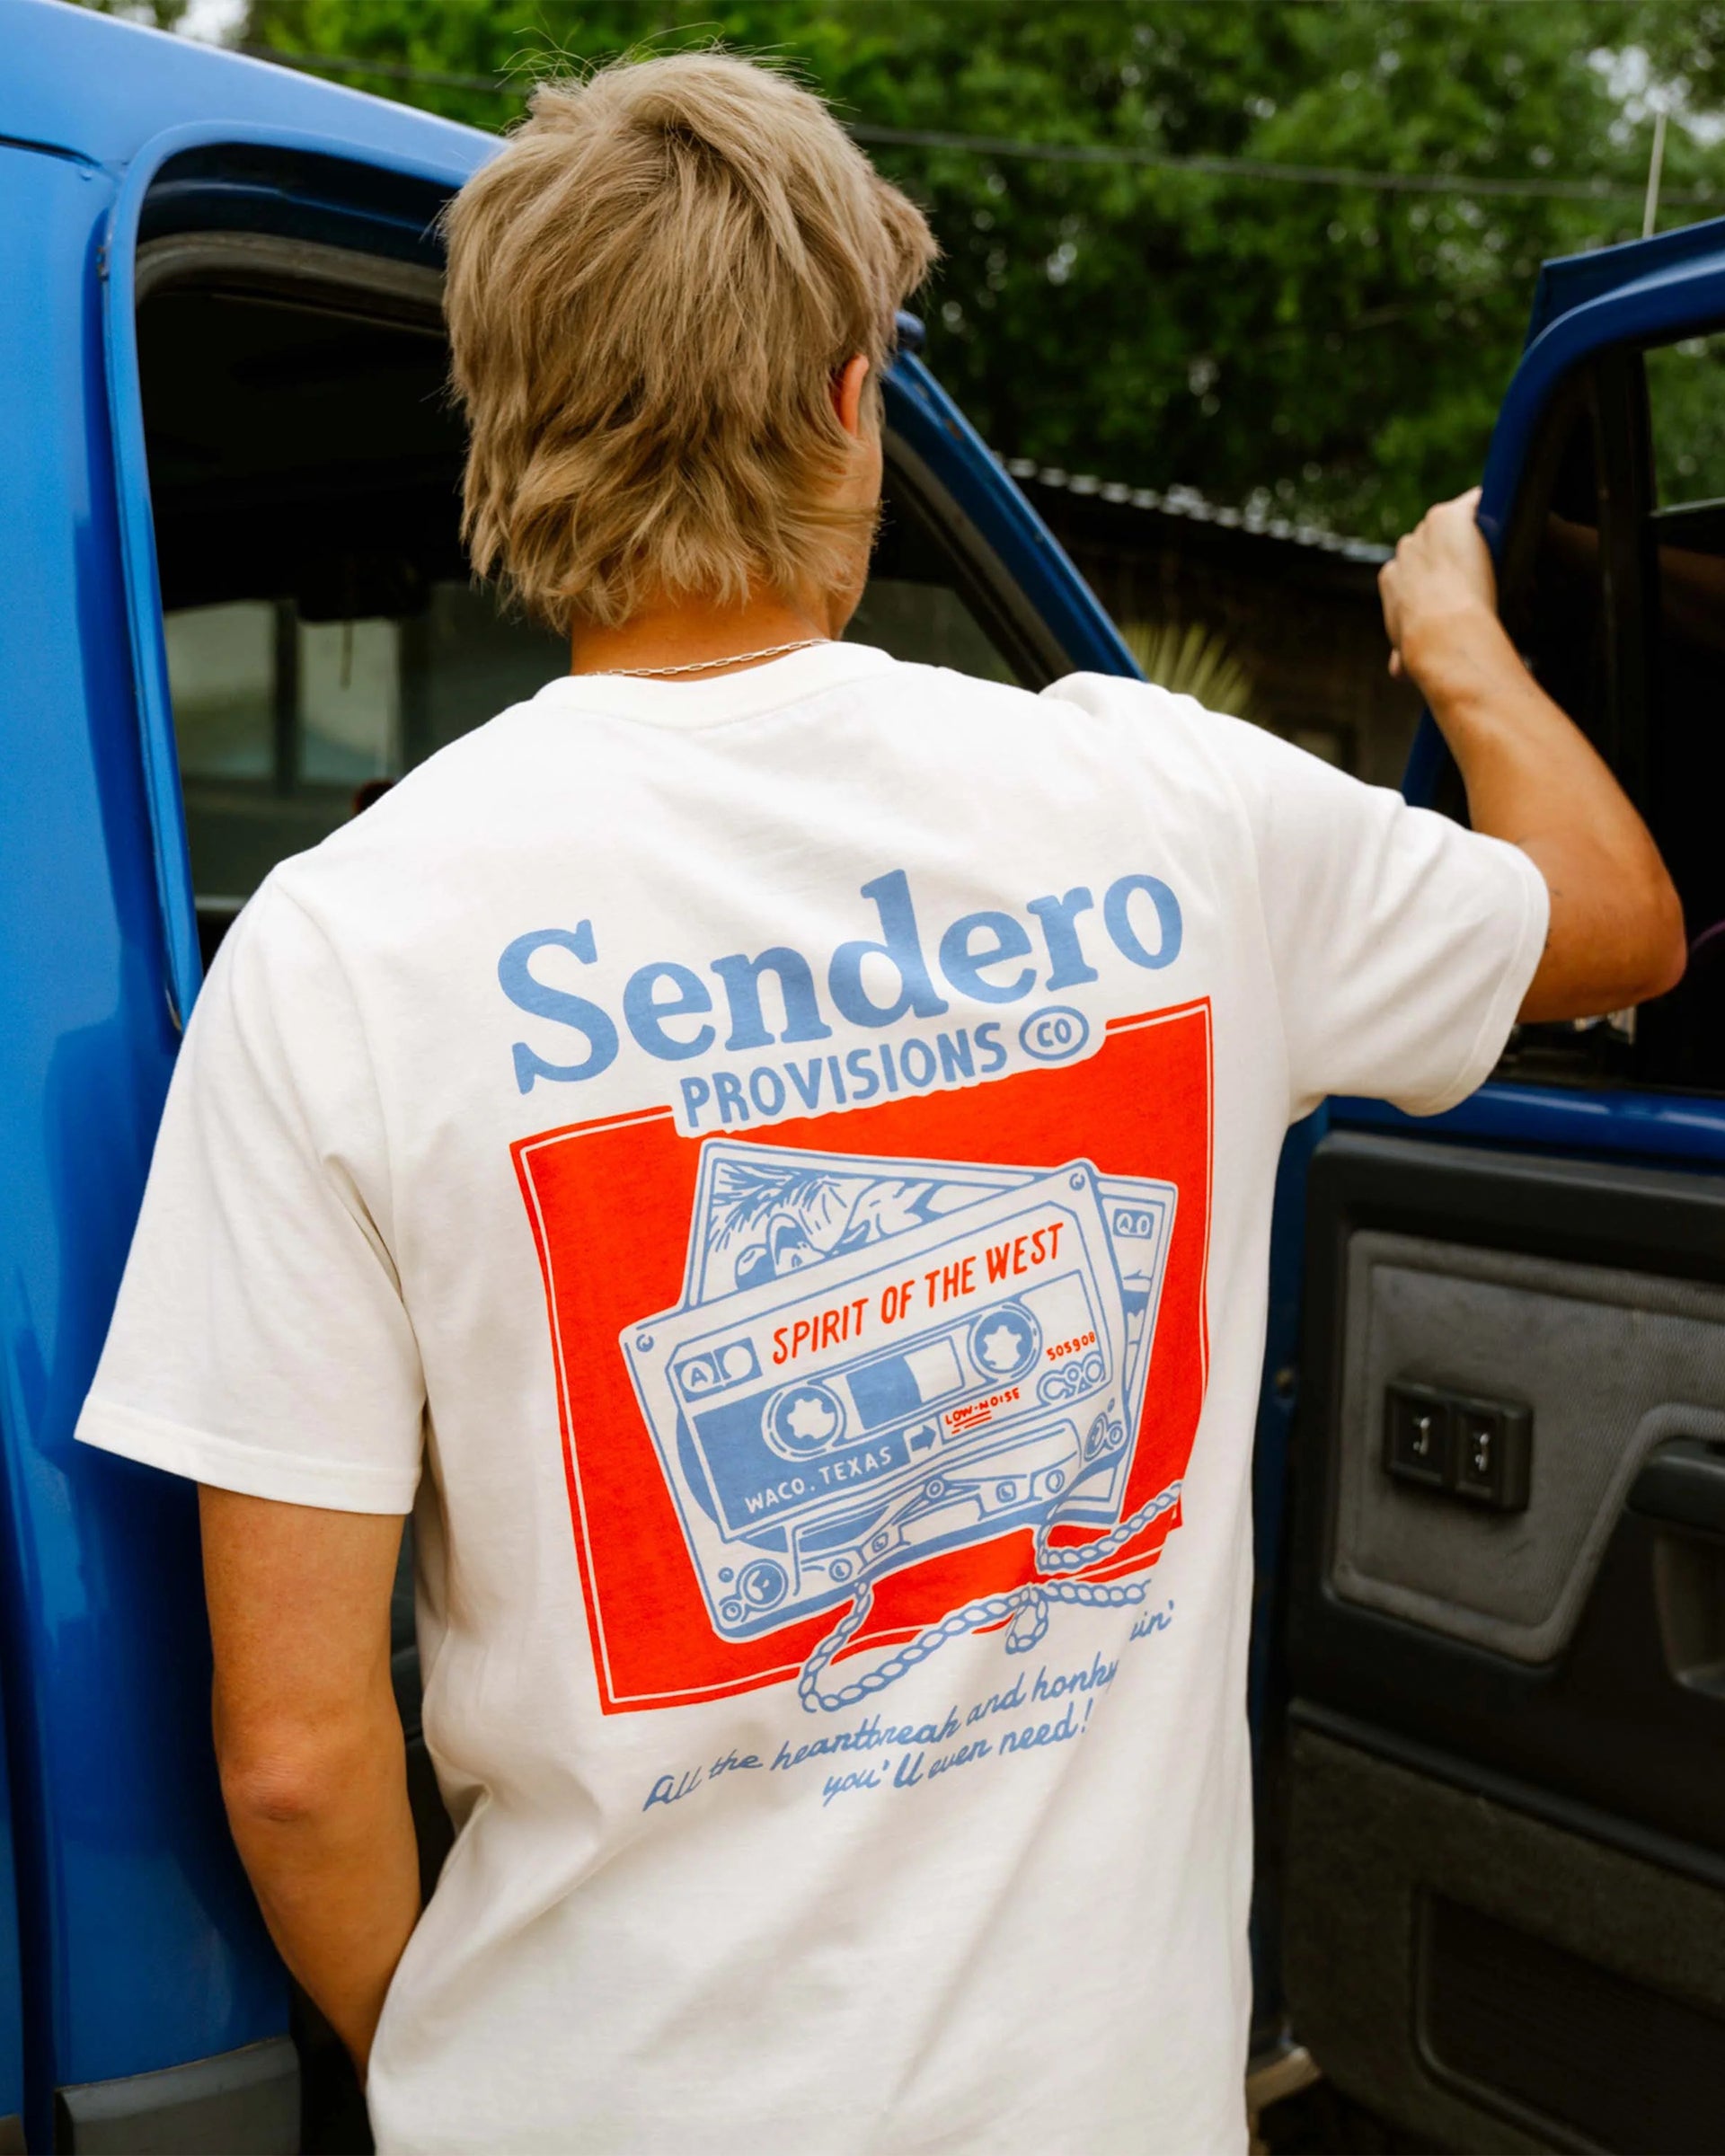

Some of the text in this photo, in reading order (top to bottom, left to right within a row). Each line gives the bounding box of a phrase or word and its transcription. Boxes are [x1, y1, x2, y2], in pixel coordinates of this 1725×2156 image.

[497, 869, 1183, 1096] Sendero
[679, 1018, 1072, 1128] PROVISIONS CO
[772, 1221, 1065, 1365] SPIRIT OF THE WEST
[1045, 1330, 1096, 1362] 505908
[944, 1386, 1021, 1426] LOW-NOISE
[818, 1445, 892, 1484] TEXAS
[641, 1765, 703, 1812] All
[708, 1748, 764, 1780] the
[770, 1705, 962, 1772] heartbreak
[966, 1671, 1026, 1727] and
[822, 1752, 924, 1807] you'll
[999, 1697, 1094, 1756] need!
